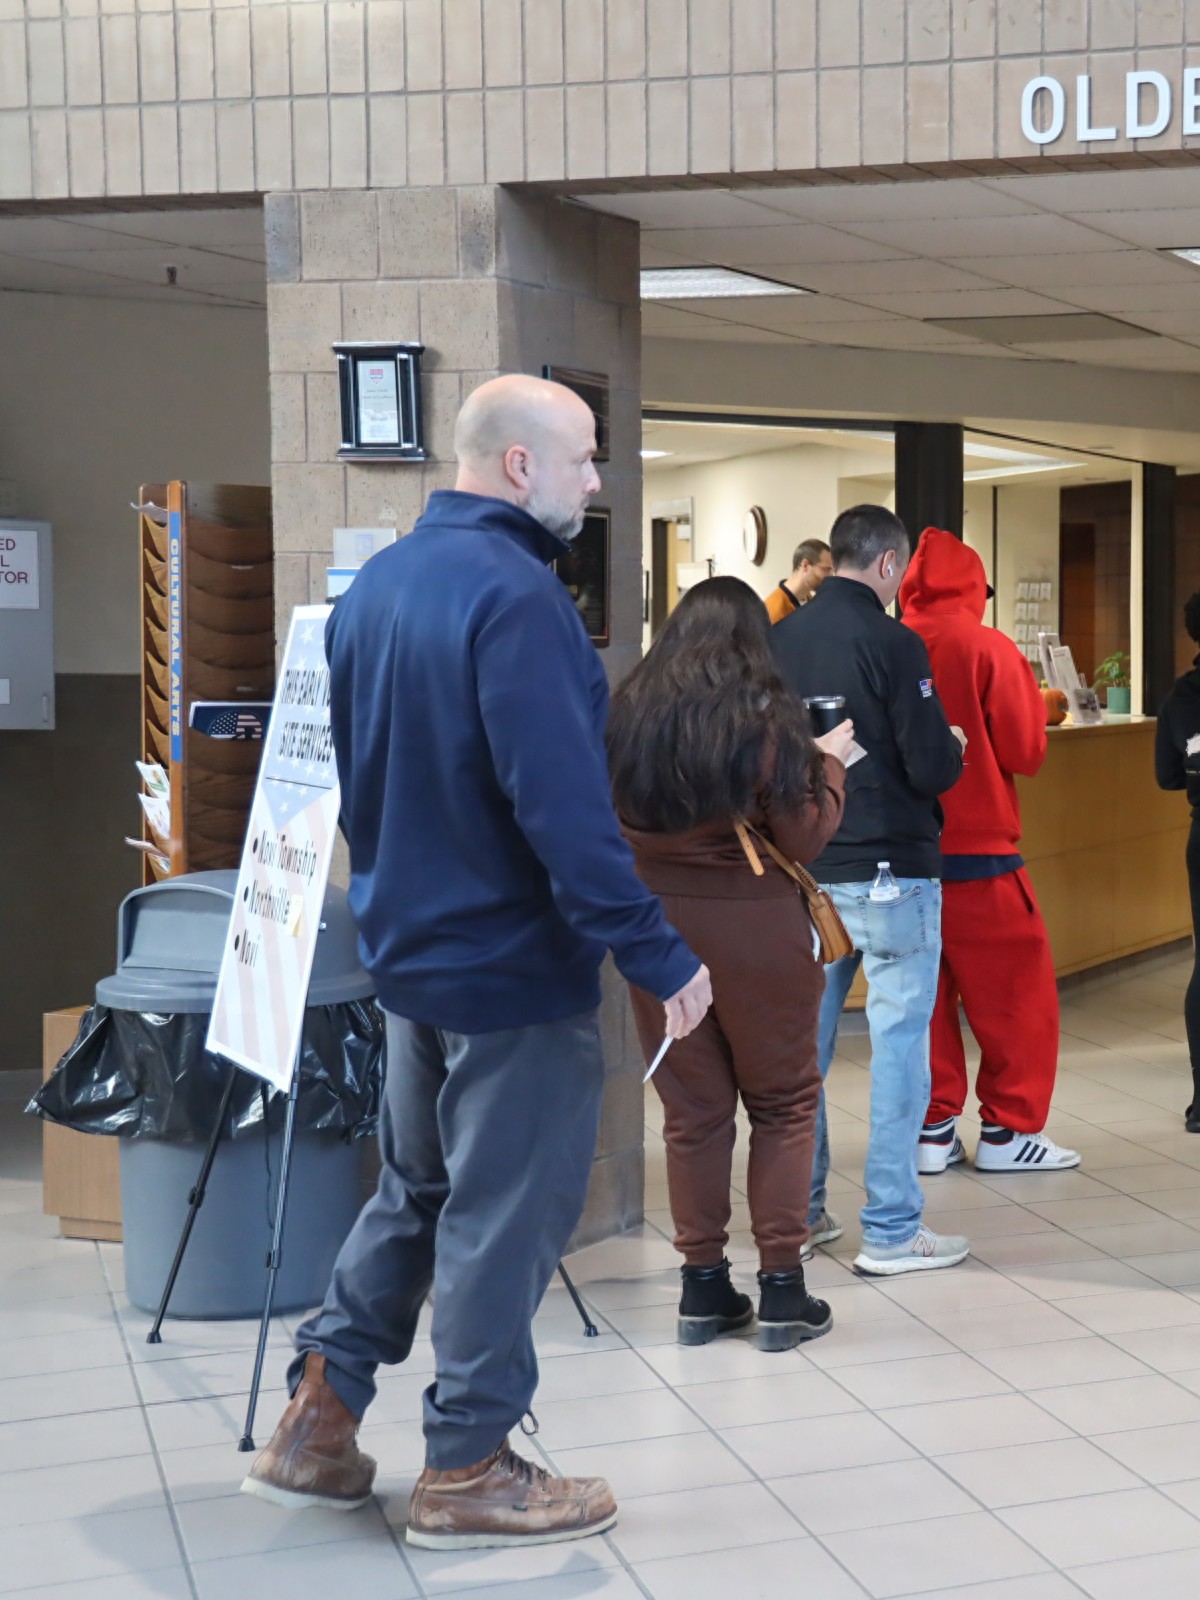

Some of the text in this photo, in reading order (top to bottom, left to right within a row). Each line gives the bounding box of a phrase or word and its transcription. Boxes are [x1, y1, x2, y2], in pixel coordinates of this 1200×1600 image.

[170, 538, 182, 736] CULTURAL ARTS
[297, 669, 324, 707] EARLY
[278, 721, 300, 758] SITE
[258, 829, 317, 887] Novi Township
[248, 879, 290, 925] Northville
[239, 928, 260, 968] Novi
